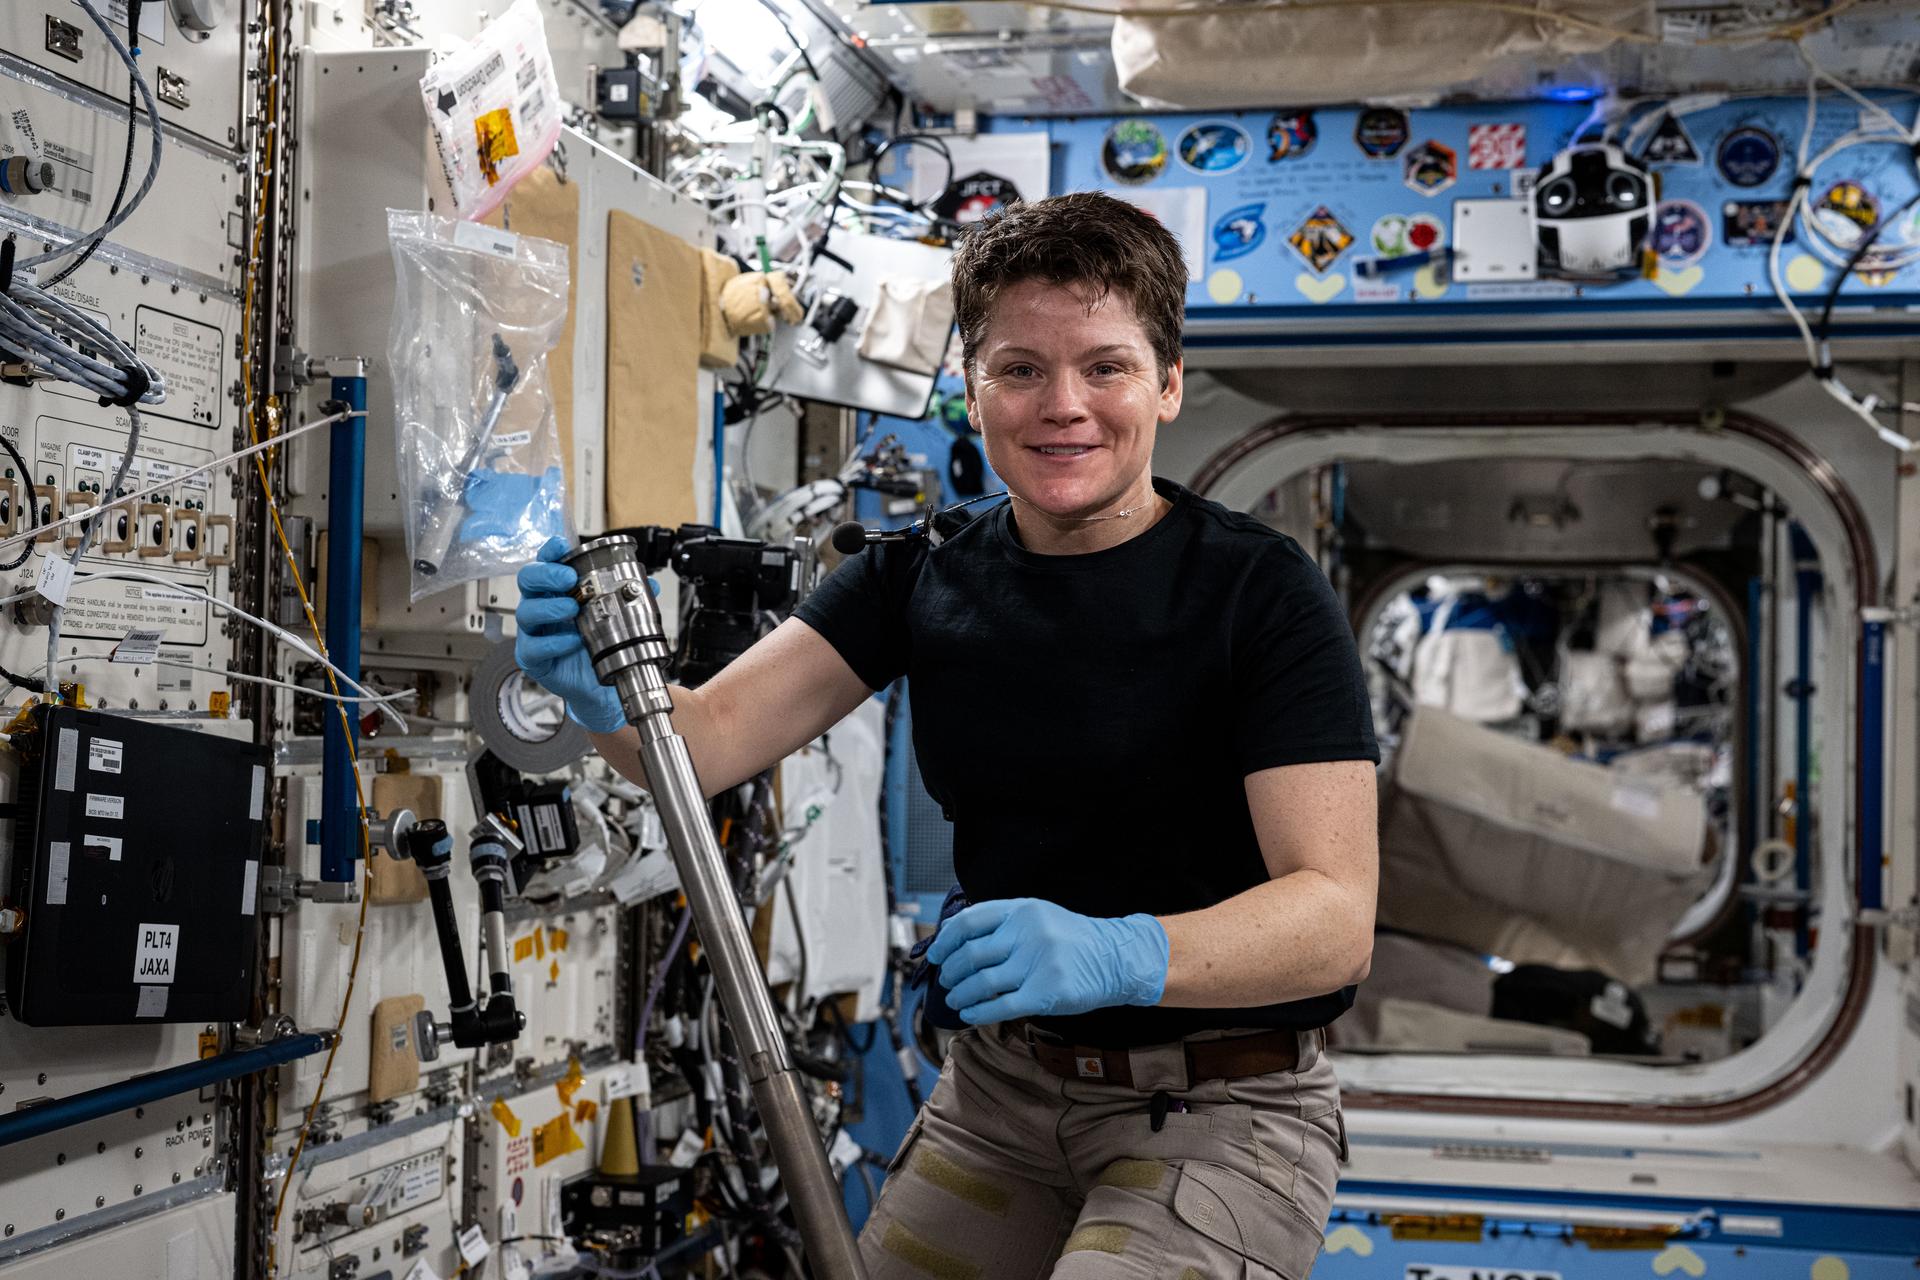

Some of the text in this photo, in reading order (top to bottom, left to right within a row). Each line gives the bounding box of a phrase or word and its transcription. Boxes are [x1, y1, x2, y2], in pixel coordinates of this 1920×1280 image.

[54, 286, 100, 308] ENABLE/DISABLE
[2, 425, 20, 437] DOOR
[40, 442, 62, 452] MAGAZINE
[19, 569, 34, 578] J124
[144, 931, 172, 949] PLT4
[140, 957, 170, 976] JAXA
[166, 1126, 213, 1148] RACK POWER
